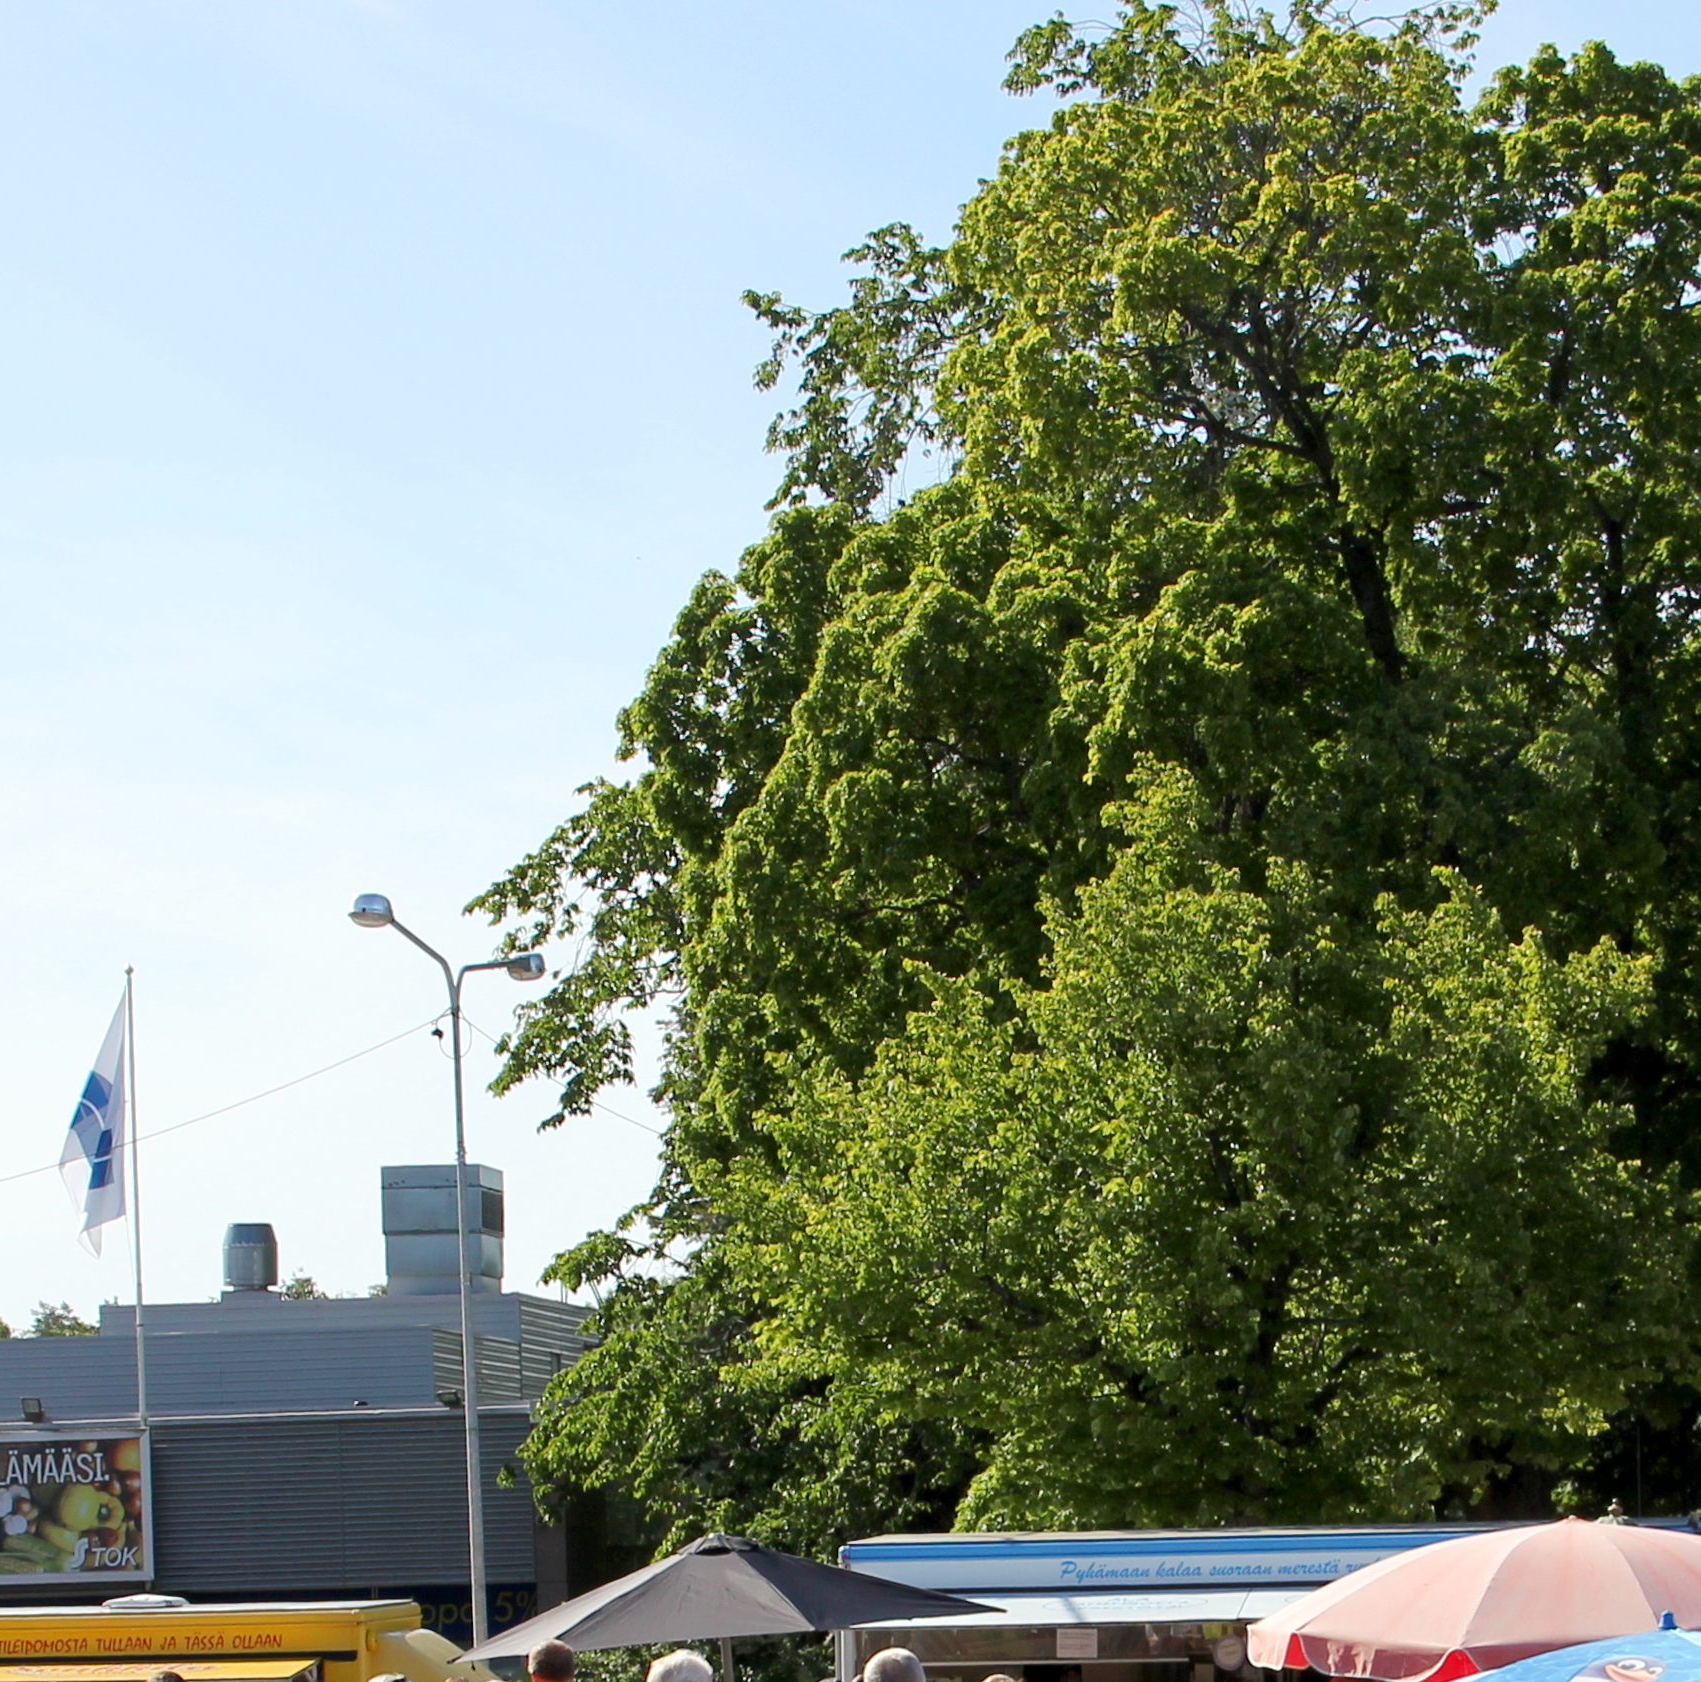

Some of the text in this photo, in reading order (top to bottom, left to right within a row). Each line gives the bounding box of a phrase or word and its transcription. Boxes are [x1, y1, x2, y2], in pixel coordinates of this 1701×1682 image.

[91, 1546, 138, 1569] TOK
[1060, 1560, 1150, 1583] Pyhämaan
[1155, 1562, 1203, 1577] kalaa
[1209, 1563, 1272, 1577] suoraan
[1278, 1559, 1341, 1576] merestä
[96, 1636, 152, 1651] TULLAAN
[160, 1636, 177, 1651] JA
[184, 1631, 225, 1650] TÄSSÄ
[232, 1634, 283, 1649] OLLAAN
